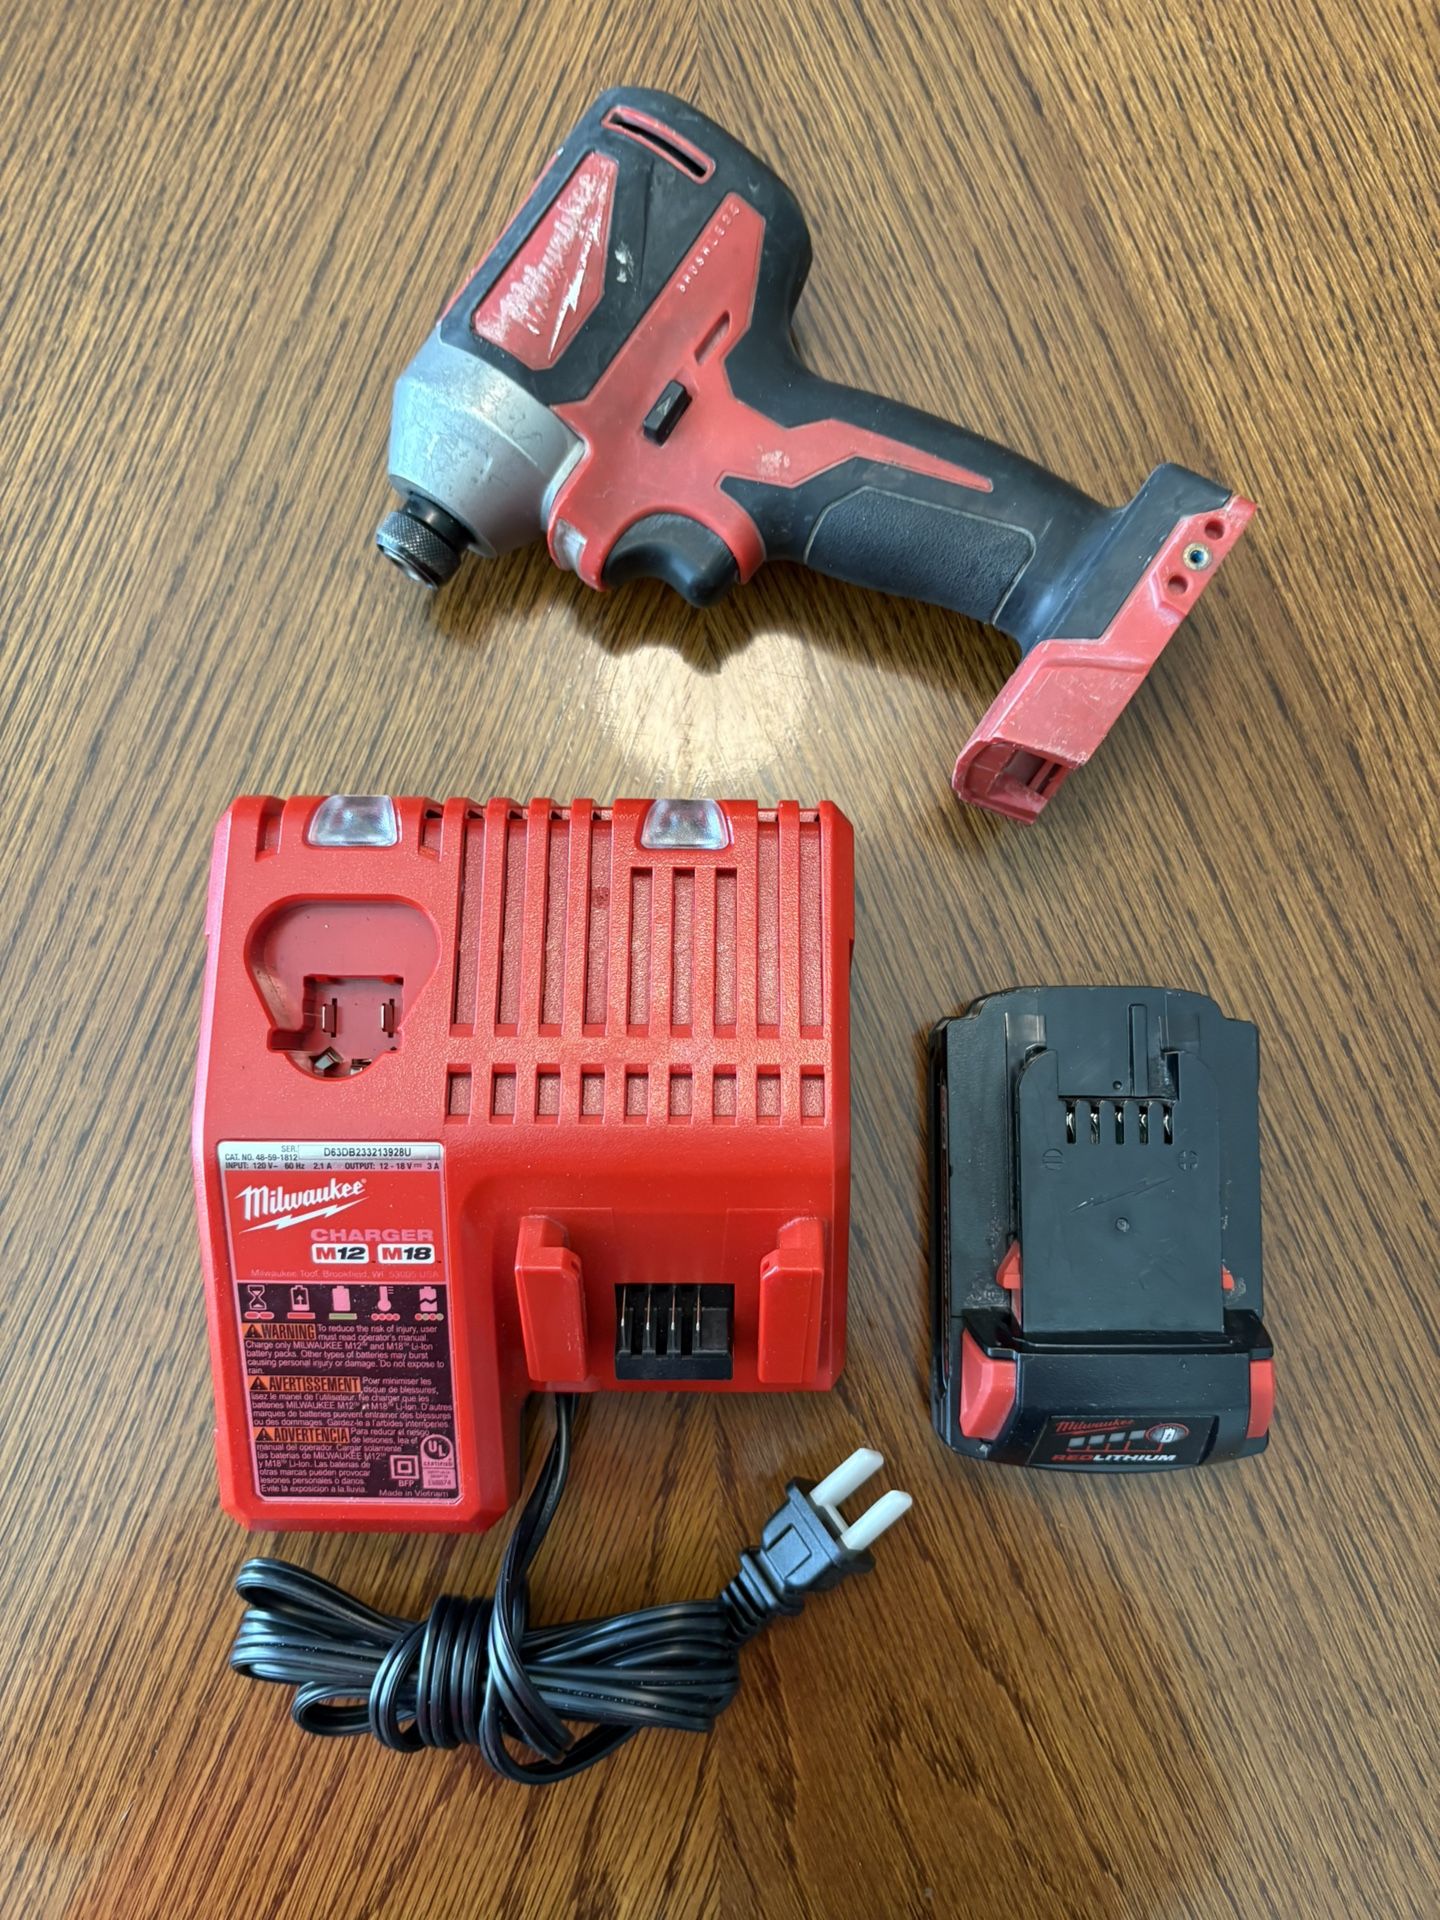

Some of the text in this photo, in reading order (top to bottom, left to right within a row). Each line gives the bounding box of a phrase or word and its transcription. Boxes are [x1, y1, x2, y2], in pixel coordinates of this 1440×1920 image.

[324, 1147, 411, 1157] D63DB233213928U
[234, 1178, 365, 1221] Milwaukee
[310, 1228, 434, 1241] CHARGER
[316, 1247, 432, 1260] M12 M18
[262, 1324, 315, 1339] WARNING
[317, 1324, 326, 1332] To
[358, 1334, 396, 1343] operator's
[245, 1341, 273, 1350] Charge
[275, 1341, 291, 1351] only
[246, 1350, 272, 1359] battery
[300, 1350, 322, 1358] Other
[324, 1351, 344, 1359] types
[390, 1352, 407, 1360] may
[409, 1351, 428, 1359] burst
[247, 1359, 277, 1368] causing
[278, 1359, 311, 1368] personal
[312, 1360, 333, 1368] injury
[407, 1361, 435, 1369] expose
[437, 1360, 444, 1368] to
[269, 1376, 359, 1392] AVERTISSEMENT
[362, 1376, 432, 1385] Pour minimiser les
[371, 1394, 400, 1403] charger
[253, 1411, 285, 1419] marques
[1055, 1419, 1134, 1433] Milwaukee
[274, 1428, 348, 1442] ADVERTENCIA
[350, 1427, 369, 1435] Para
[336, 1444, 362, 1453] Cargar
[428, 1440, 446, 1457] UL
[313, 1452, 362, 1460] MILWAUKEE
[1051, 1454, 1177, 1462] REDLITHIUM
[314, 1460, 328, 1468] Las
[309, 1469, 336, 1478] pueden
[339, 1470, 370, 1478] provocar
[293, 1477, 332, 1486] personales
